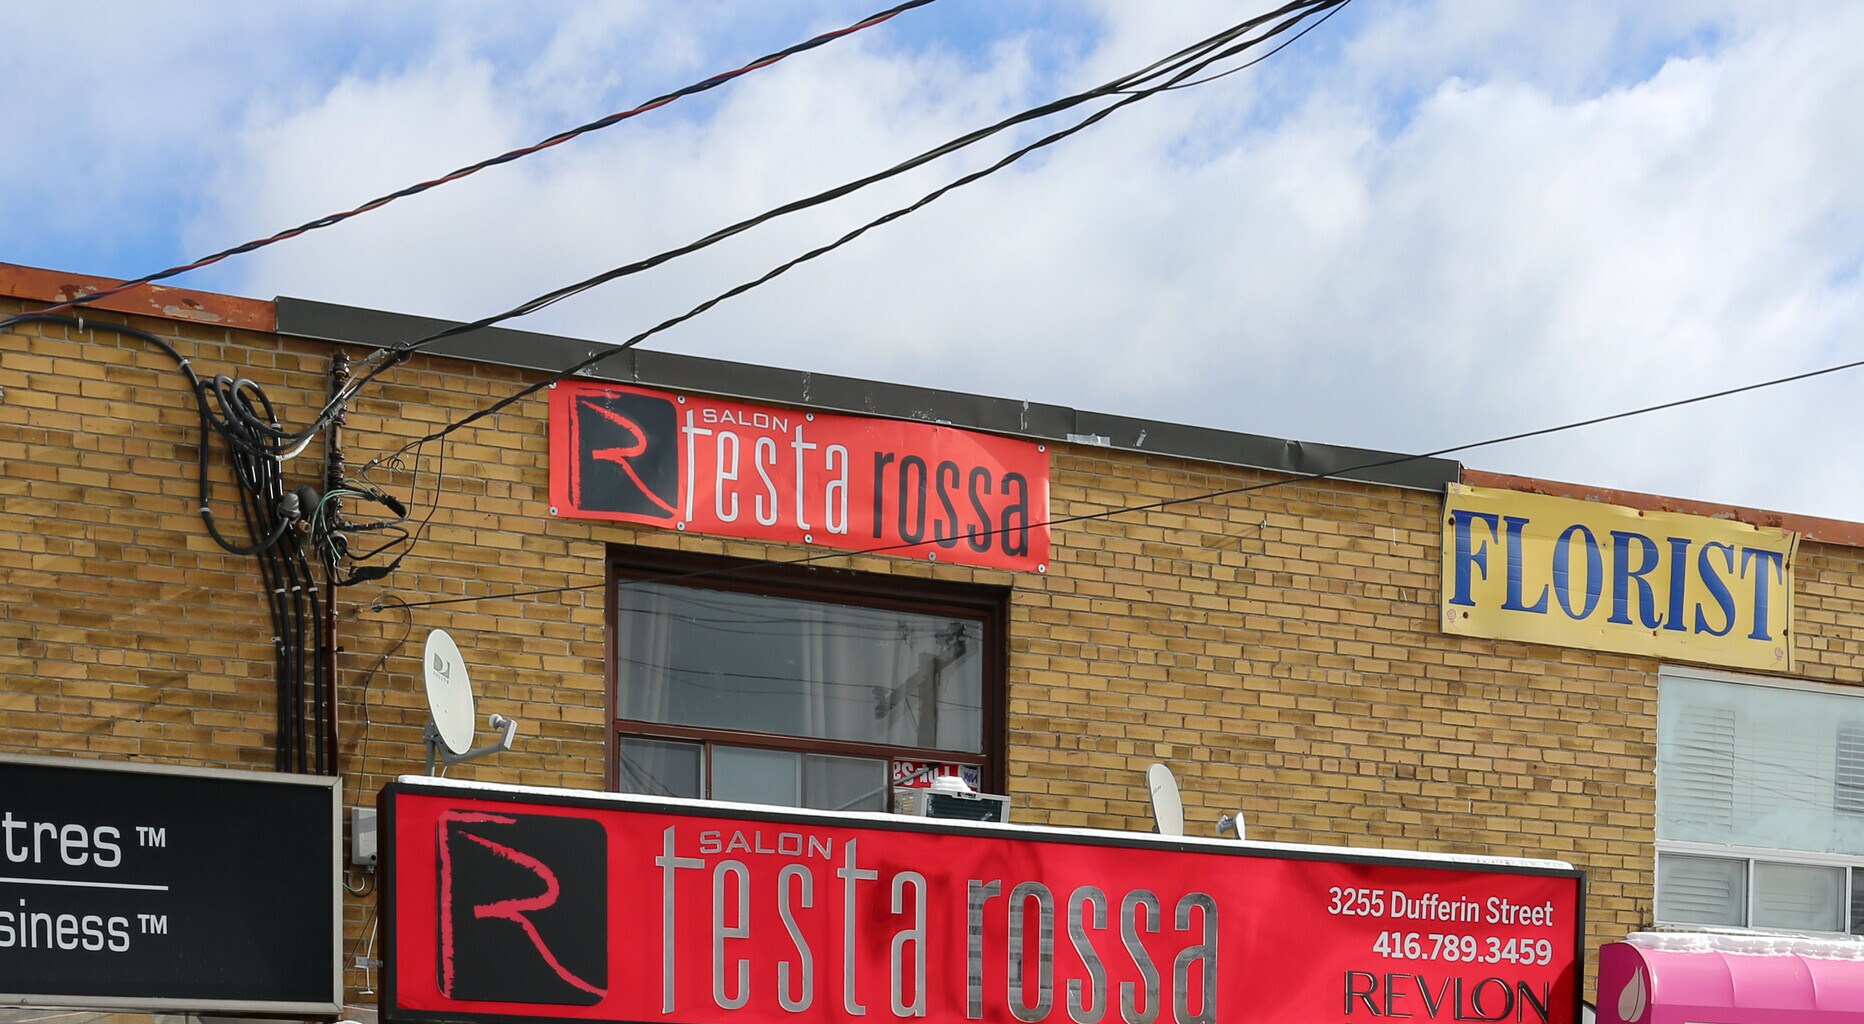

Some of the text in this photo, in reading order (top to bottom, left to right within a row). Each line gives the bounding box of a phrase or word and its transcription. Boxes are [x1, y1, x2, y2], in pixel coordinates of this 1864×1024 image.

[702, 408, 788, 433] SALON
[873, 450, 1028, 557] rossa
[1448, 509, 1784, 642] FLORIST
[699, 830, 832, 860] SALON
[1328, 886, 1553, 927] 3255 Dufferin Street
[1372, 931, 1552, 966] 416.789.3459
[1345, 970, 1549, 1024] REVLON
